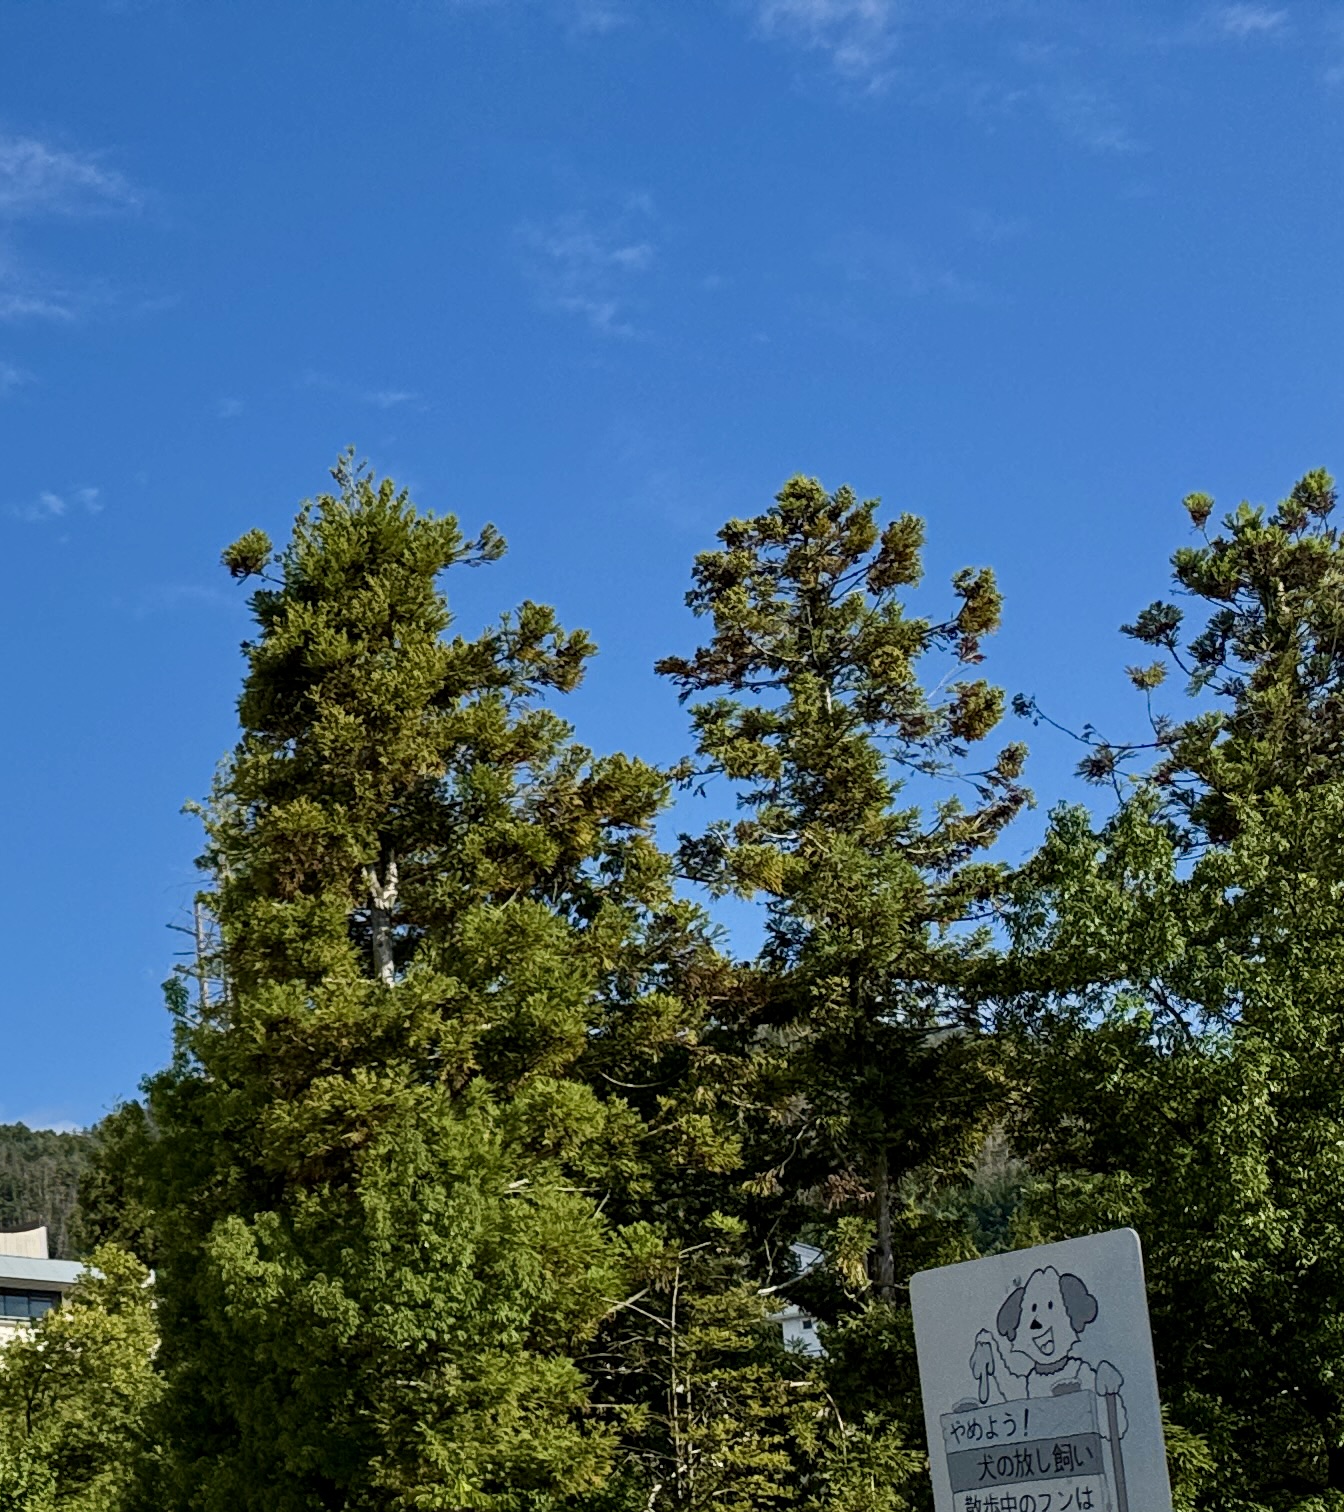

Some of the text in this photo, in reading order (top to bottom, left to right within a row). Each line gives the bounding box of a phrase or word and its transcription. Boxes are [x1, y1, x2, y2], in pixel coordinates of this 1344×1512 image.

[976, 1443, 1093, 1481] 犬の放し飼い
